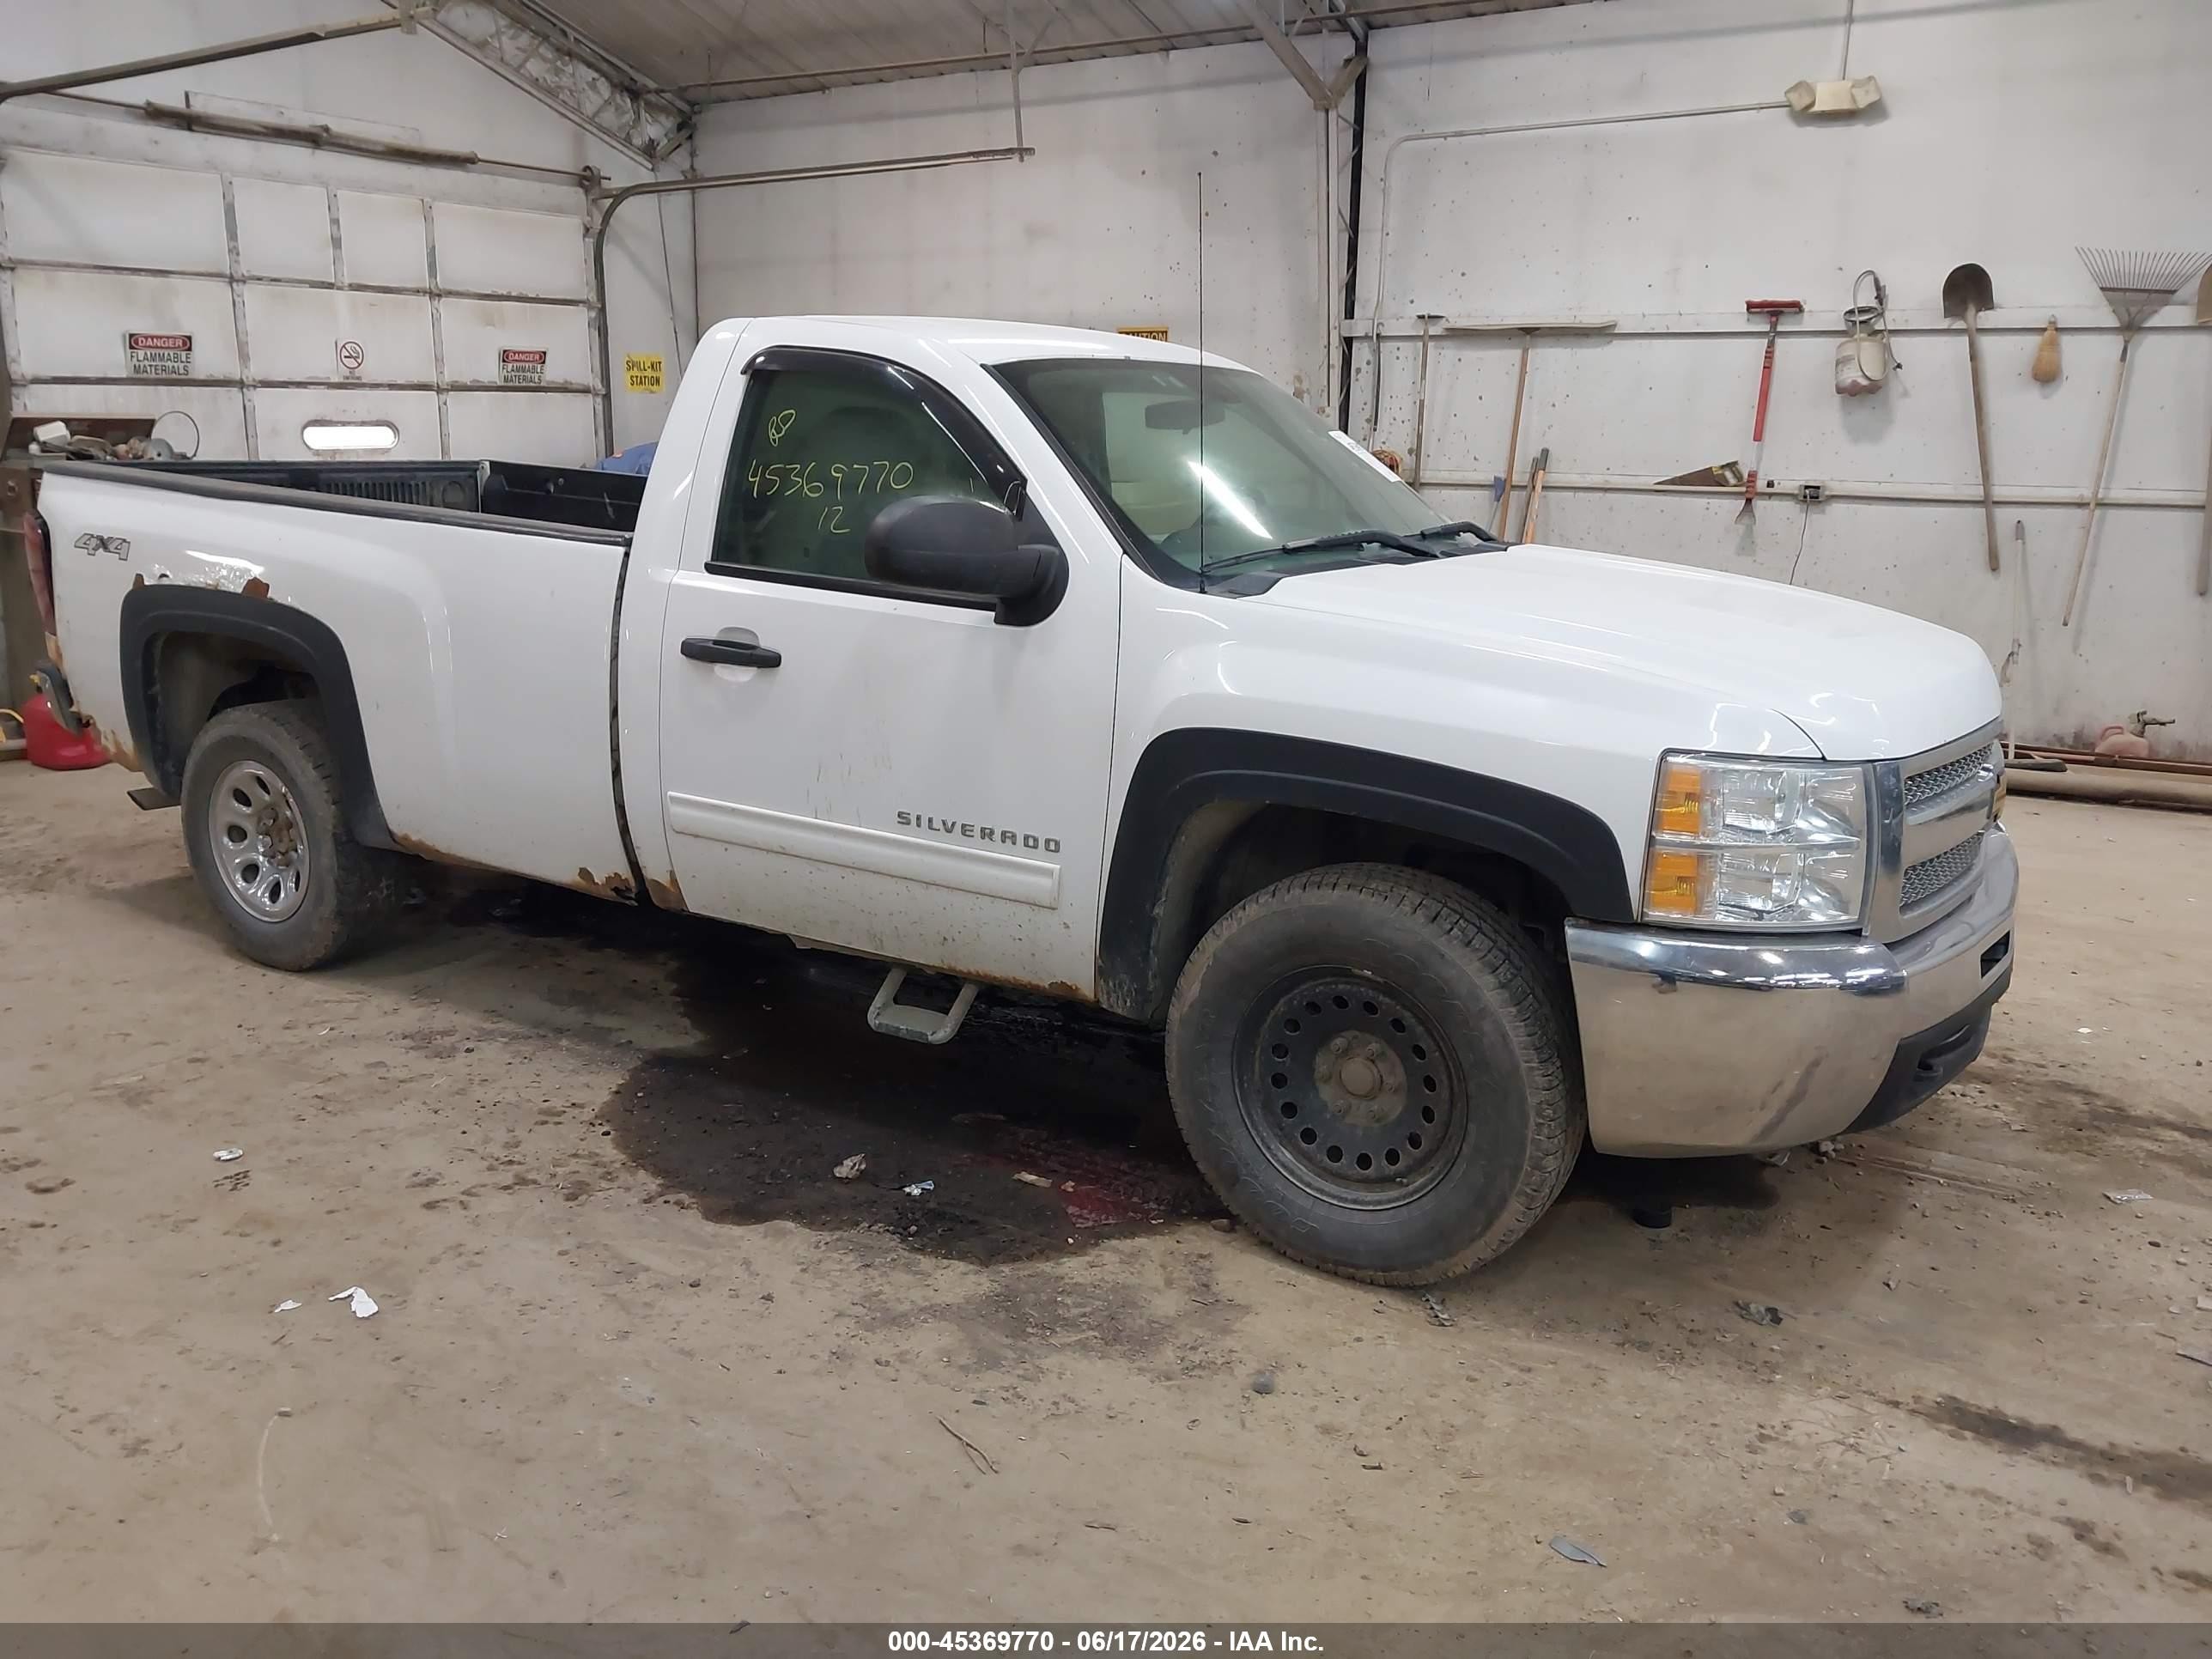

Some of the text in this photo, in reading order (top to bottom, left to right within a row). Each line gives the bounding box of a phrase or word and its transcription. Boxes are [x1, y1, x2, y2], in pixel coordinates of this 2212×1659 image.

[138, 337, 184, 347] DANGER
[130, 350, 191, 364] FLAMMABLE
[508, 352, 540, 361] DANGER
[133, 363, 189, 376] MATERIALS
[502, 363, 544, 374] FLAMMABLE
[625, 360, 662, 372] SPILL-KIT
[503, 374, 543, 385] MATERIALS
[629, 374, 660, 386] STATION
[748, 459, 914, 501] 45369770
[817, 506, 851, 533] 12
[896, 811, 1061, 854] SILVERADO
